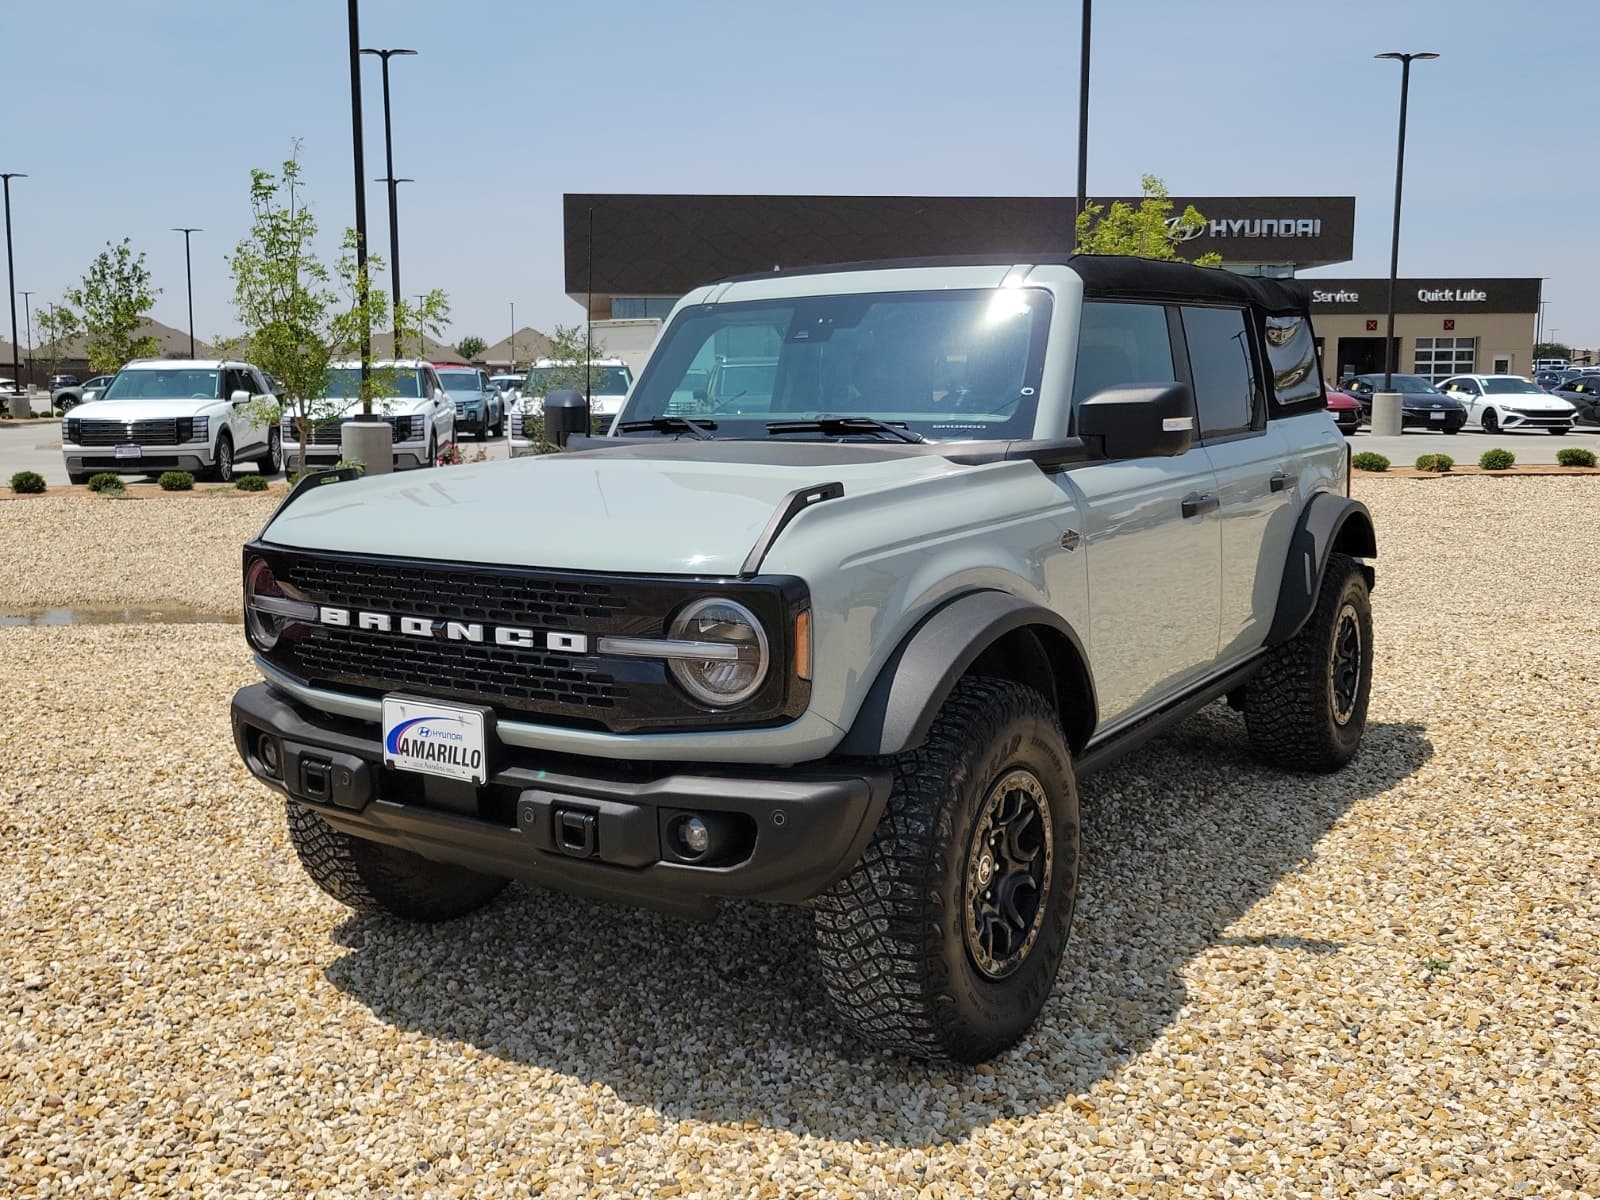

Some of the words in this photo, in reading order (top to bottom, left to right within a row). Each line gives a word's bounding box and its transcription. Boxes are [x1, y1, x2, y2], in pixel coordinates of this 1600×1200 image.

[1209, 219, 1321, 238] HYUNDAI
[1312, 290, 1359, 303] Service
[1417, 289, 1454, 302] Quick
[1456, 289, 1487, 302] Lube
[320, 606, 588, 652] BRONCO
[432, 729, 463, 742] HYUNDAI
[400, 738, 481, 769] AMARILLO
